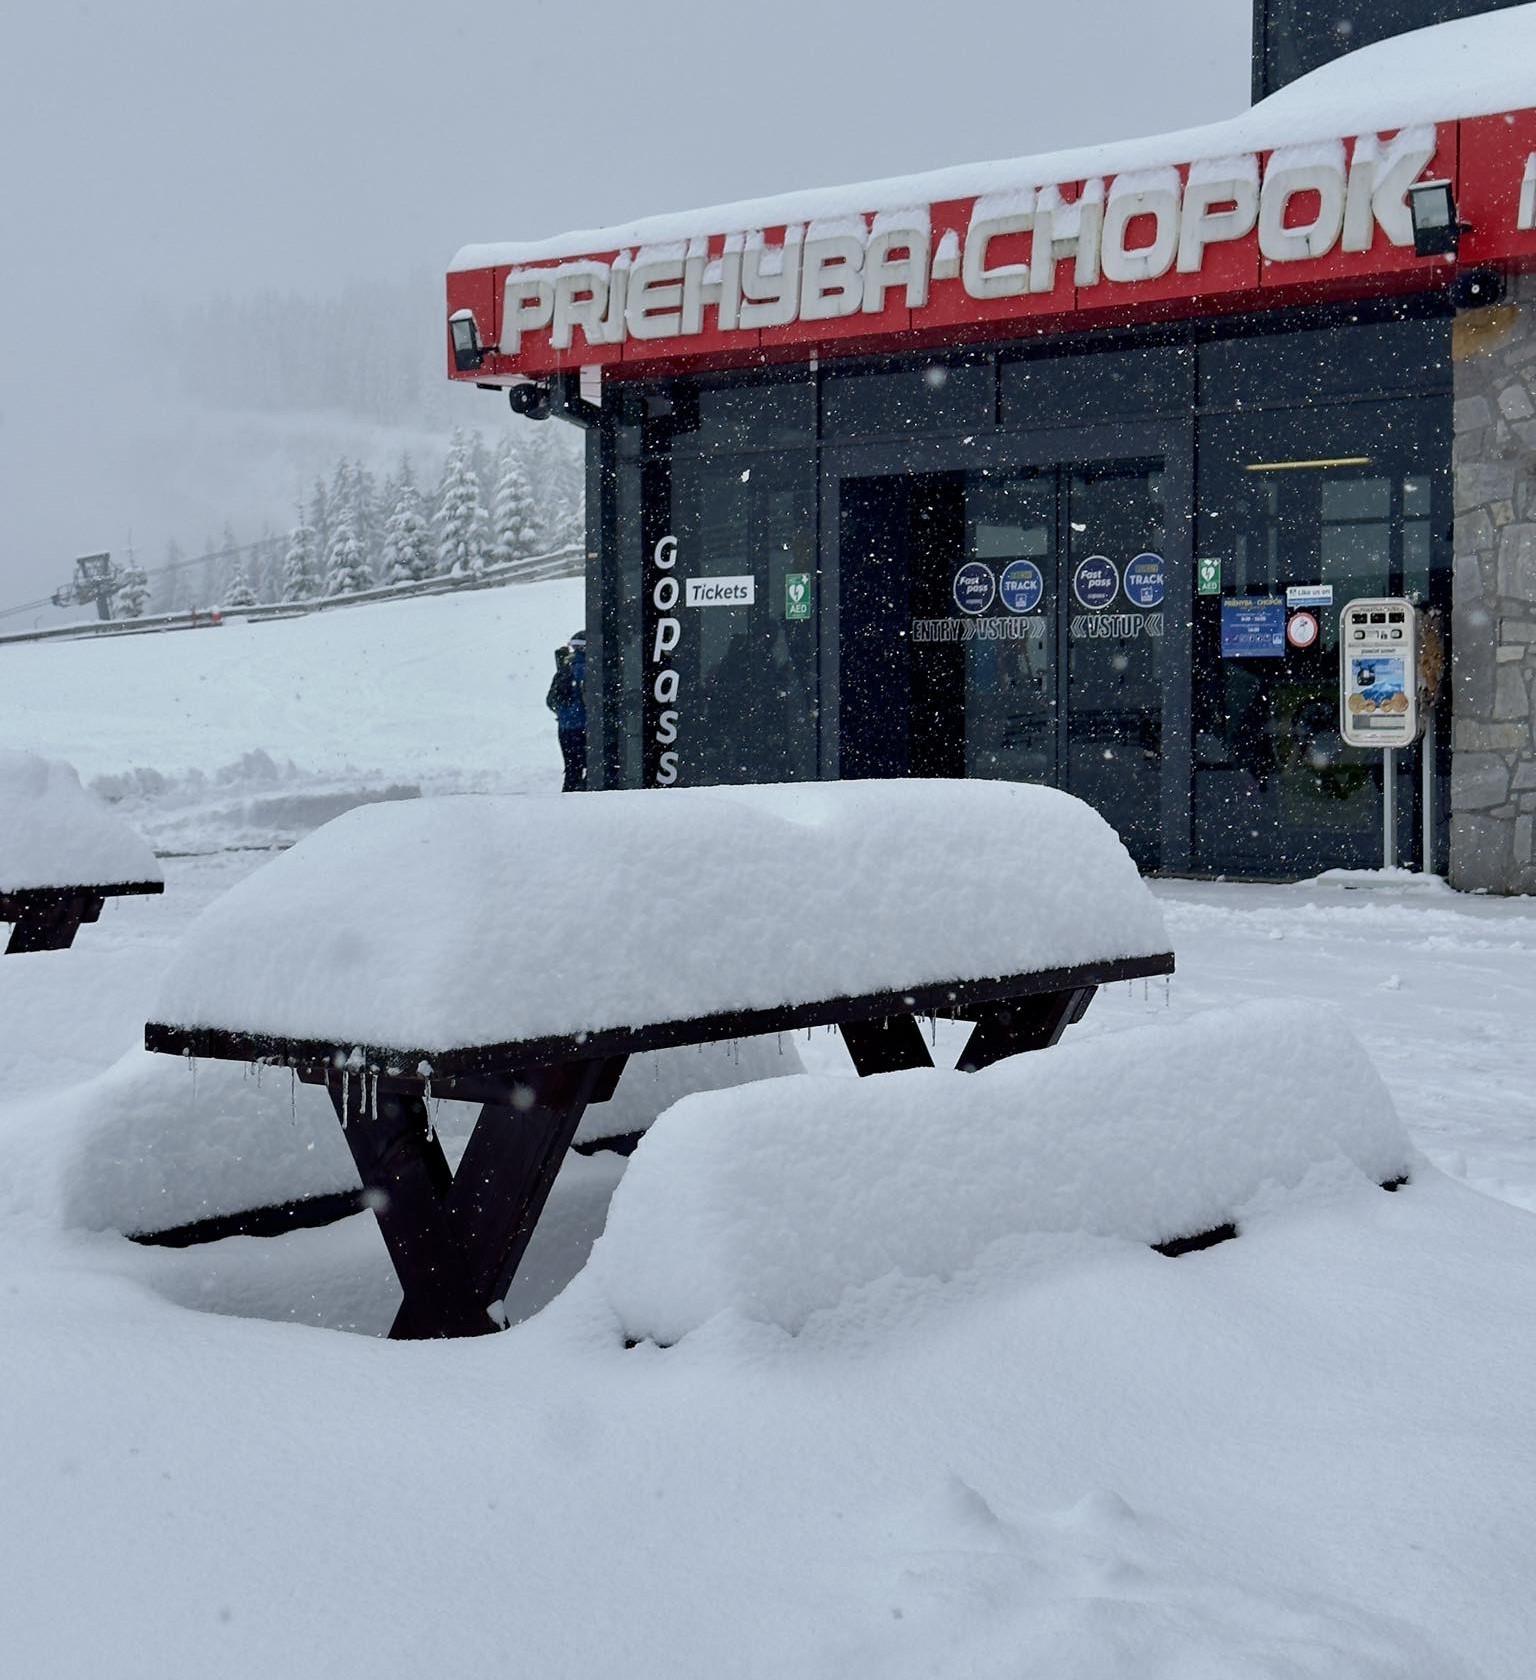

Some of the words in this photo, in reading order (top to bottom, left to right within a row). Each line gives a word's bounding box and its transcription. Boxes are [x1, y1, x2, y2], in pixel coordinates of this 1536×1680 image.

[1080, 570, 1102, 579] Fast
[1129, 574, 1164, 585] TRACK
[959, 576, 979, 585] Fast
[1005, 580, 1037, 591] TRACK
[1088, 578, 1112, 589] pass
[1202, 582, 1217, 590] AED
[692, 584, 748, 600] Tickets
[966, 584, 989, 594] pass
[790, 604, 807, 614] AED
[912, 618, 961, 642] ENTRY
[975, 616, 1031, 640] VSTUP
[1088, 614, 1145, 639] VSTUP
